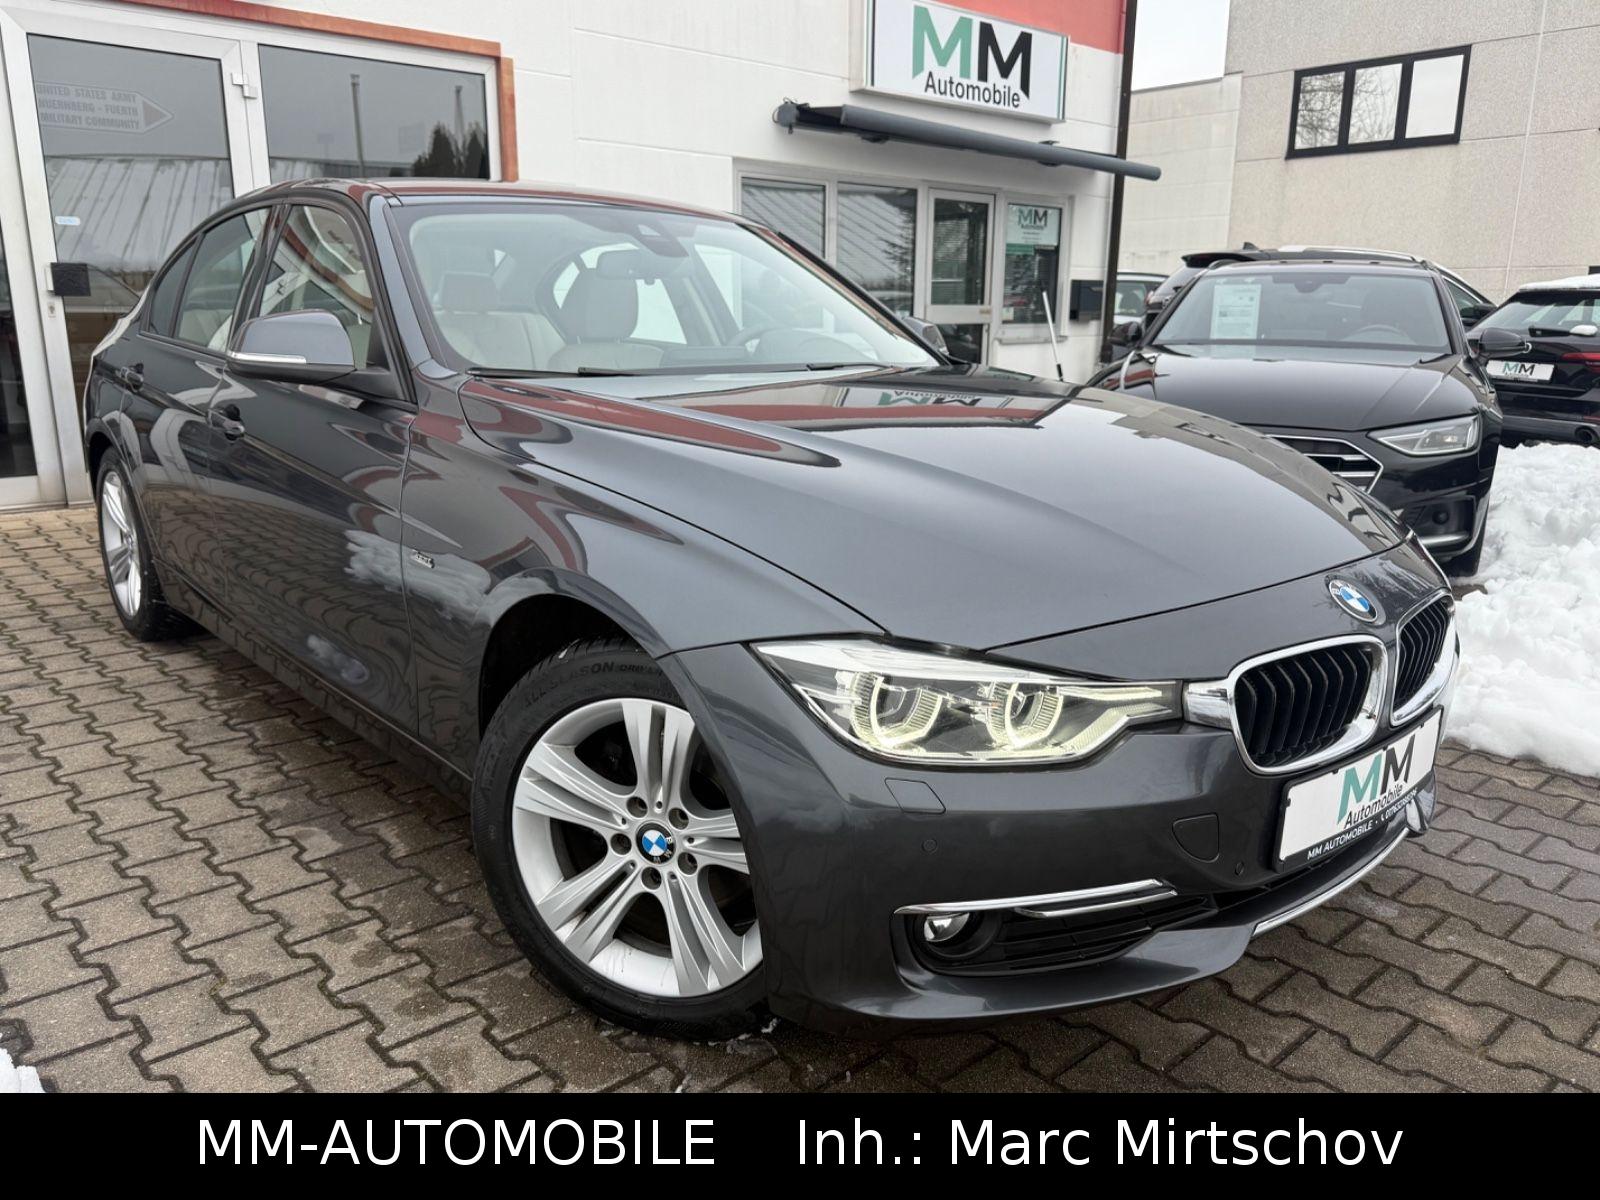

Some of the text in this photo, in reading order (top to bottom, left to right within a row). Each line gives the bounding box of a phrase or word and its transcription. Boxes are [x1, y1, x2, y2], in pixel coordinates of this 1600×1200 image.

[912, 5, 1032, 100] MM
[36, 84, 137, 103] UNITED STATES ARMY
[924, 71, 1020, 108] Automobile
[38, 98, 95, 113] NUERNBERG
[104, 104, 139, 116] FUERTH
[40, 112, 139, 130] MILITARY COMMUNITY
[1018, 208, 1048, 227] MM
[1502, 362, 1535, 376] MM
[1337, 734, 1416, 826] MM
[1344, 784, 1403, 830] Automobile
[1307, 821, 1373, 860] MM AUTOMOBILE
